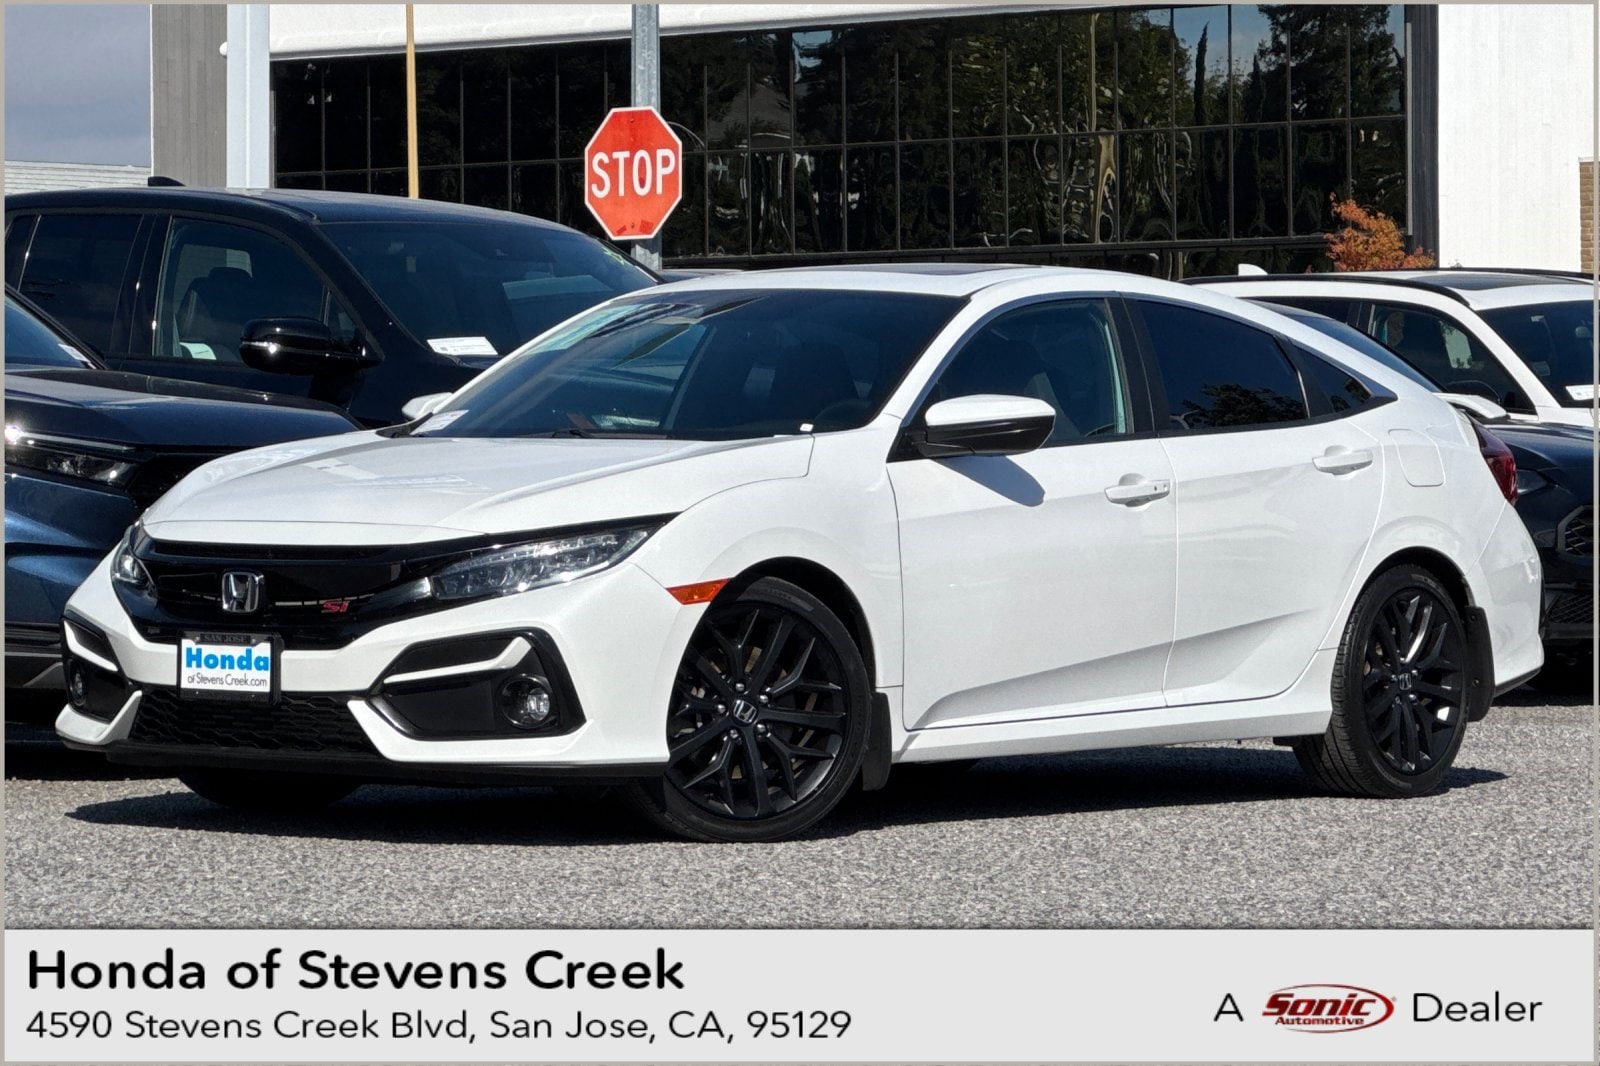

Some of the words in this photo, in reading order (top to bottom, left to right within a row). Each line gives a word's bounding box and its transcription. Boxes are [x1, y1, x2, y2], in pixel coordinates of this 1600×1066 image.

[591, 148, 676, 199] STOP
[204, 633, 222, 643] SAN
[186, 647, 269, 671] Honda
[187, 674, 196, 684] of
[196, 672, 224, 685] Stevens
